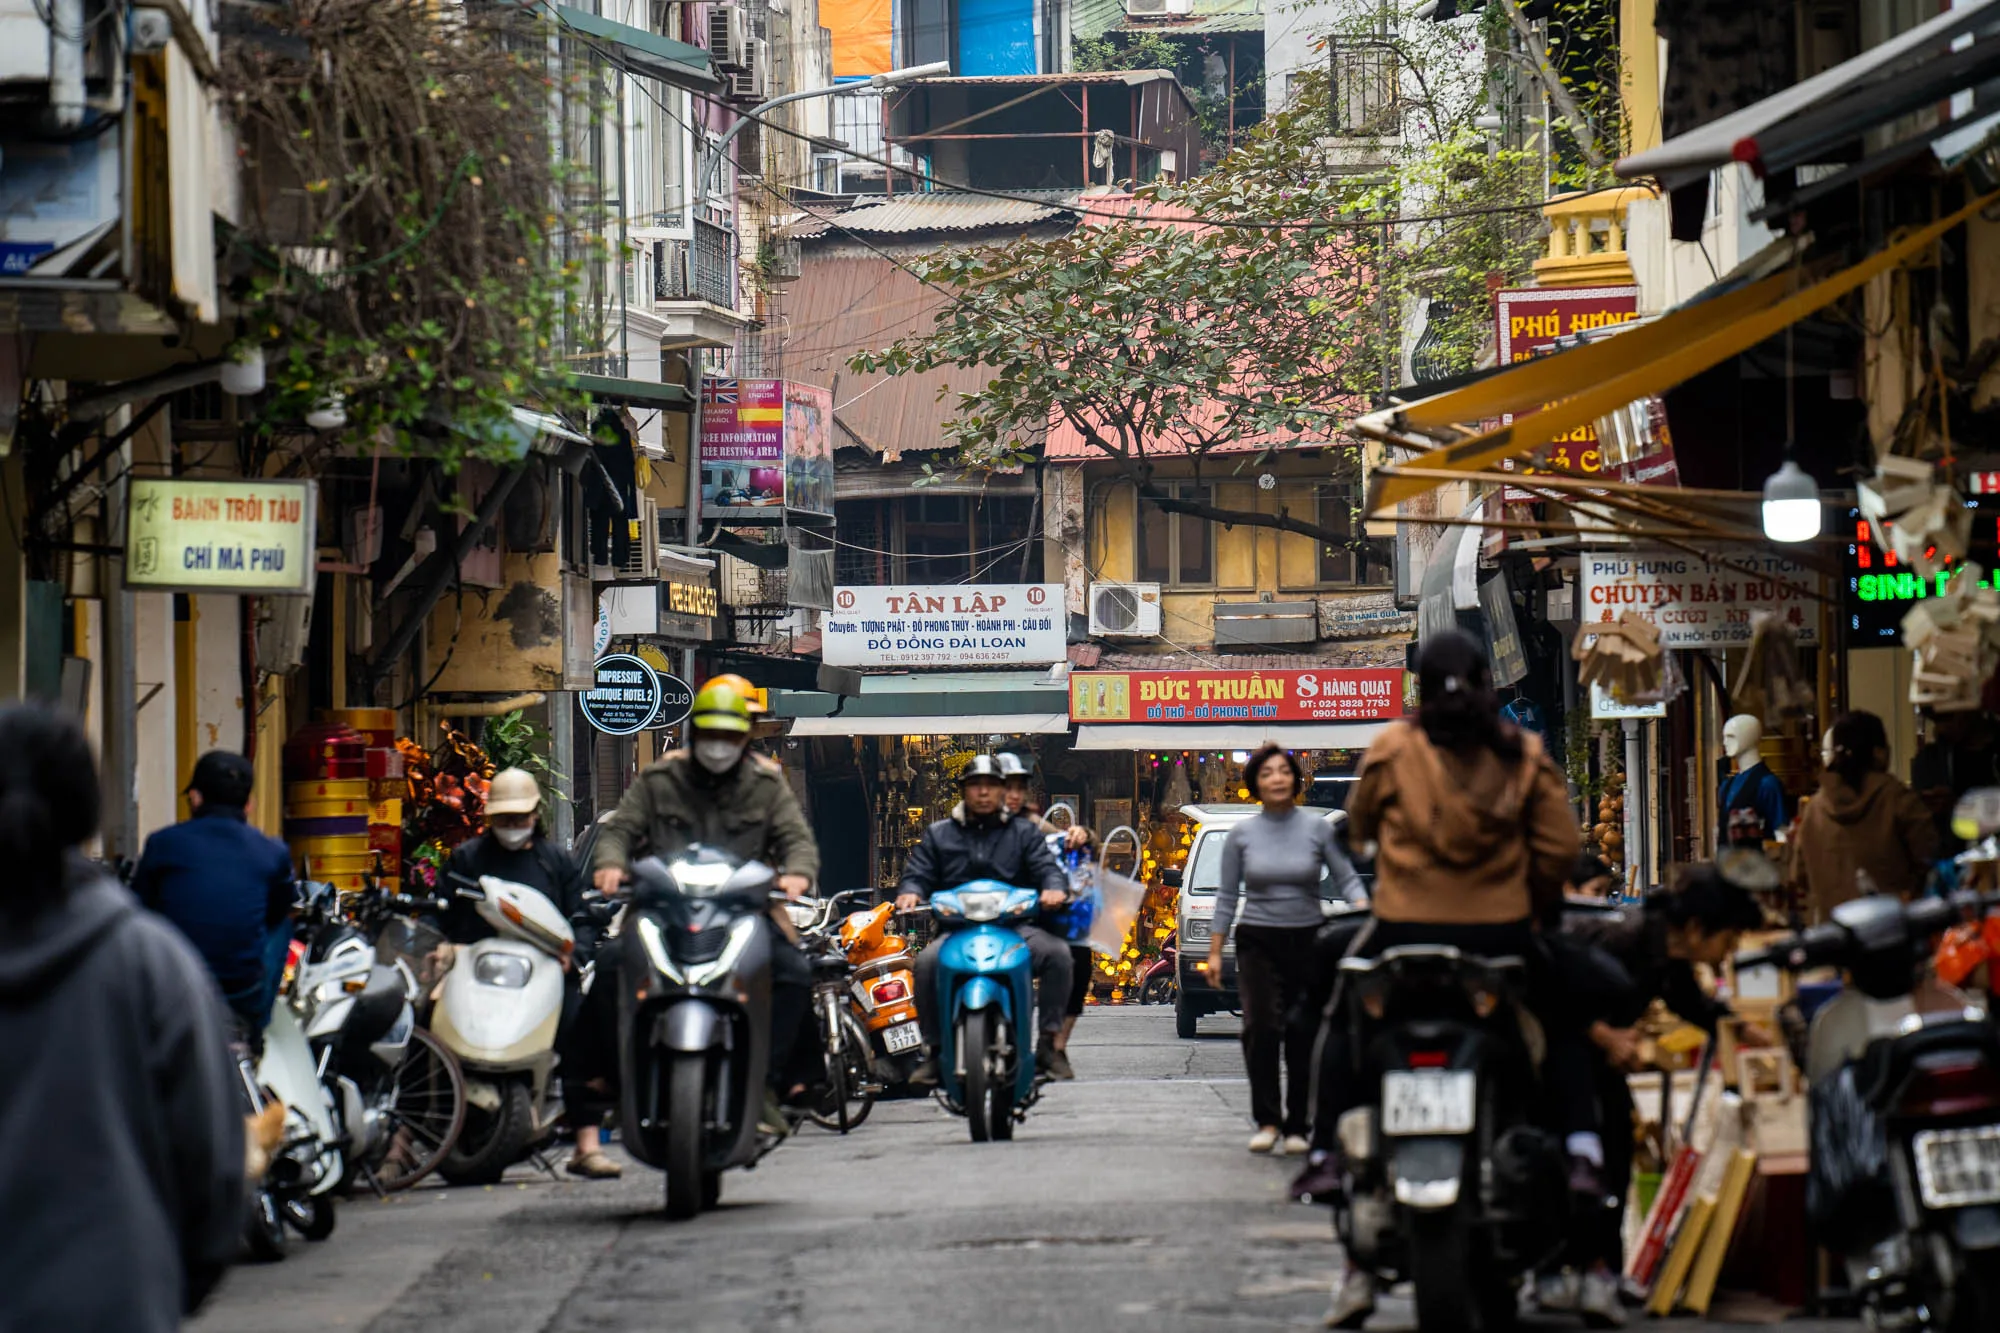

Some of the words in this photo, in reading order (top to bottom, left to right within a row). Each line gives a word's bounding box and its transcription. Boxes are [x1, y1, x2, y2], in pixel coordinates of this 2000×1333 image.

[1510, 309, 1560, 338] PHÚ
[703, 433, 719, 442] REE
[720, 432, 777, 442] INFORMATION
[702, 446, 718, 456] REE
[720, 446, 754, 456] RESTING
[756, 446, 778, 456] AREA
[184, 541, 212, 570] CHÍ
[1590, 579, 1683, 604] CHUYÊN
[1690, 577, 1737, 602] BÁN
[1858, 573, 1927, 600] SINH
[839, 594, 853, 606] 10
[886, 591, 945, 613] TÂN
[952, 591, 1006, 617] LẬP
[1030, 590, 1042, 602] 10
[924, 620, 949, 632] PHONG
[976, 618, 1001, 631] HOÀNH
[1003, 619, 1016, 631] PHI
[896, 633, 944, 649] ĐỒNG
[949, 634, 976, 648] ĐÀI
[981, 637, 1026, 648] LOAN
[597, 671, 643, 683] IMPRESSIVE
[1139, 676, 1190, 700] ĐỨC
[1197, 671, 1284, 700] THUẦN
[1296, 674, 1319, 697] 8
[1323, 678, 1356, 696] HÀNG
[1360, 680, 1391, 698] QUẠT
[587, 688, 622, 702] BOUTIQUE
[623, 689, 648, 701] HOTEL
[647, 690, 653, 701] 2
[1299, 700, 1316, 708] ĐT:
[1366, 699, 1390, 707] 7793
[1212, 705, 1248, 718] PHONG
[1339, 709, 1357, 717] 064
[1360, 709, 1378, 717] 119
